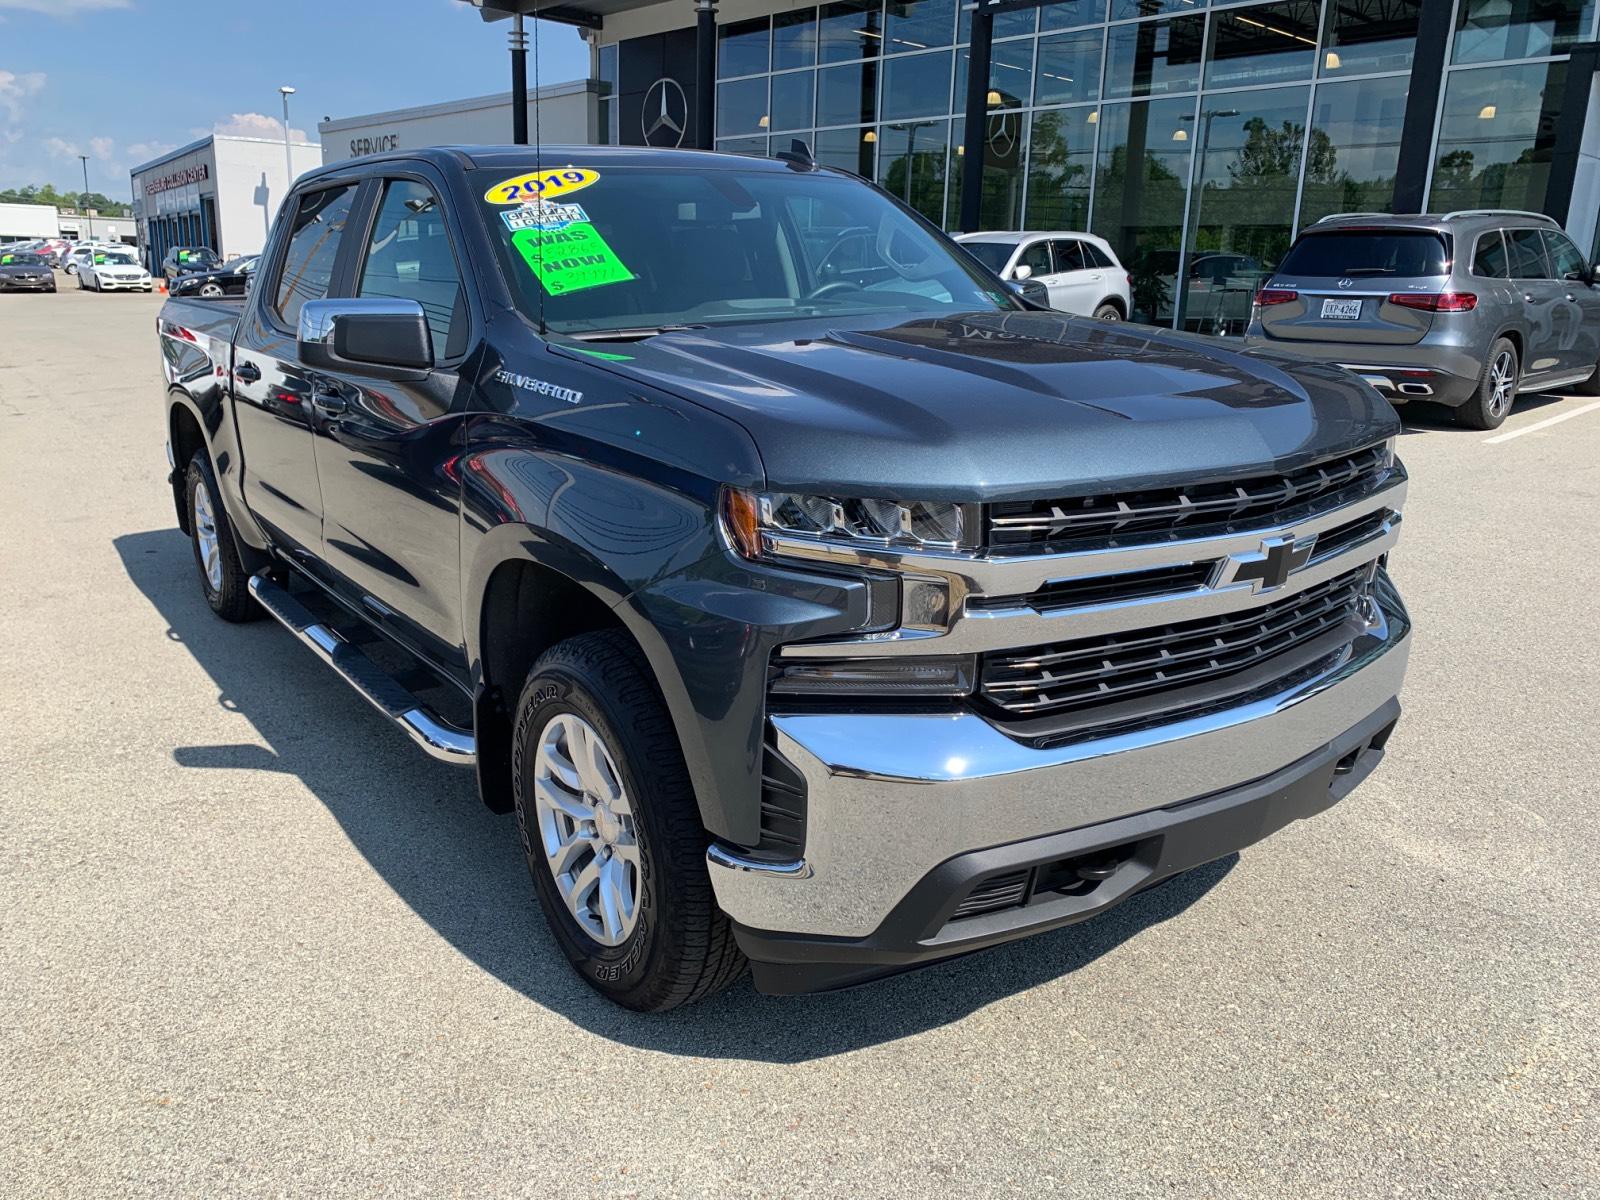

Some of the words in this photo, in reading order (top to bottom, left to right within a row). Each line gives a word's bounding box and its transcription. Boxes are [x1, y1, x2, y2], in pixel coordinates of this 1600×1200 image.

[350, 134, 398, 158] SERVICE
[501, 171, 585, 200] 2019
[507, 206, 578, 222] CARFAX
[524, 213, 582, 227] OWNER
[526, 230, 590, 248] WAS
[542, 254, 607, 273] NOW
[551, 280, 565, 291] $
[495, 369, 584, 404] SILVERADO
[512, 684, 559, 856] GOODYEAR
[595, 808, 651, 982] WRANGLER
